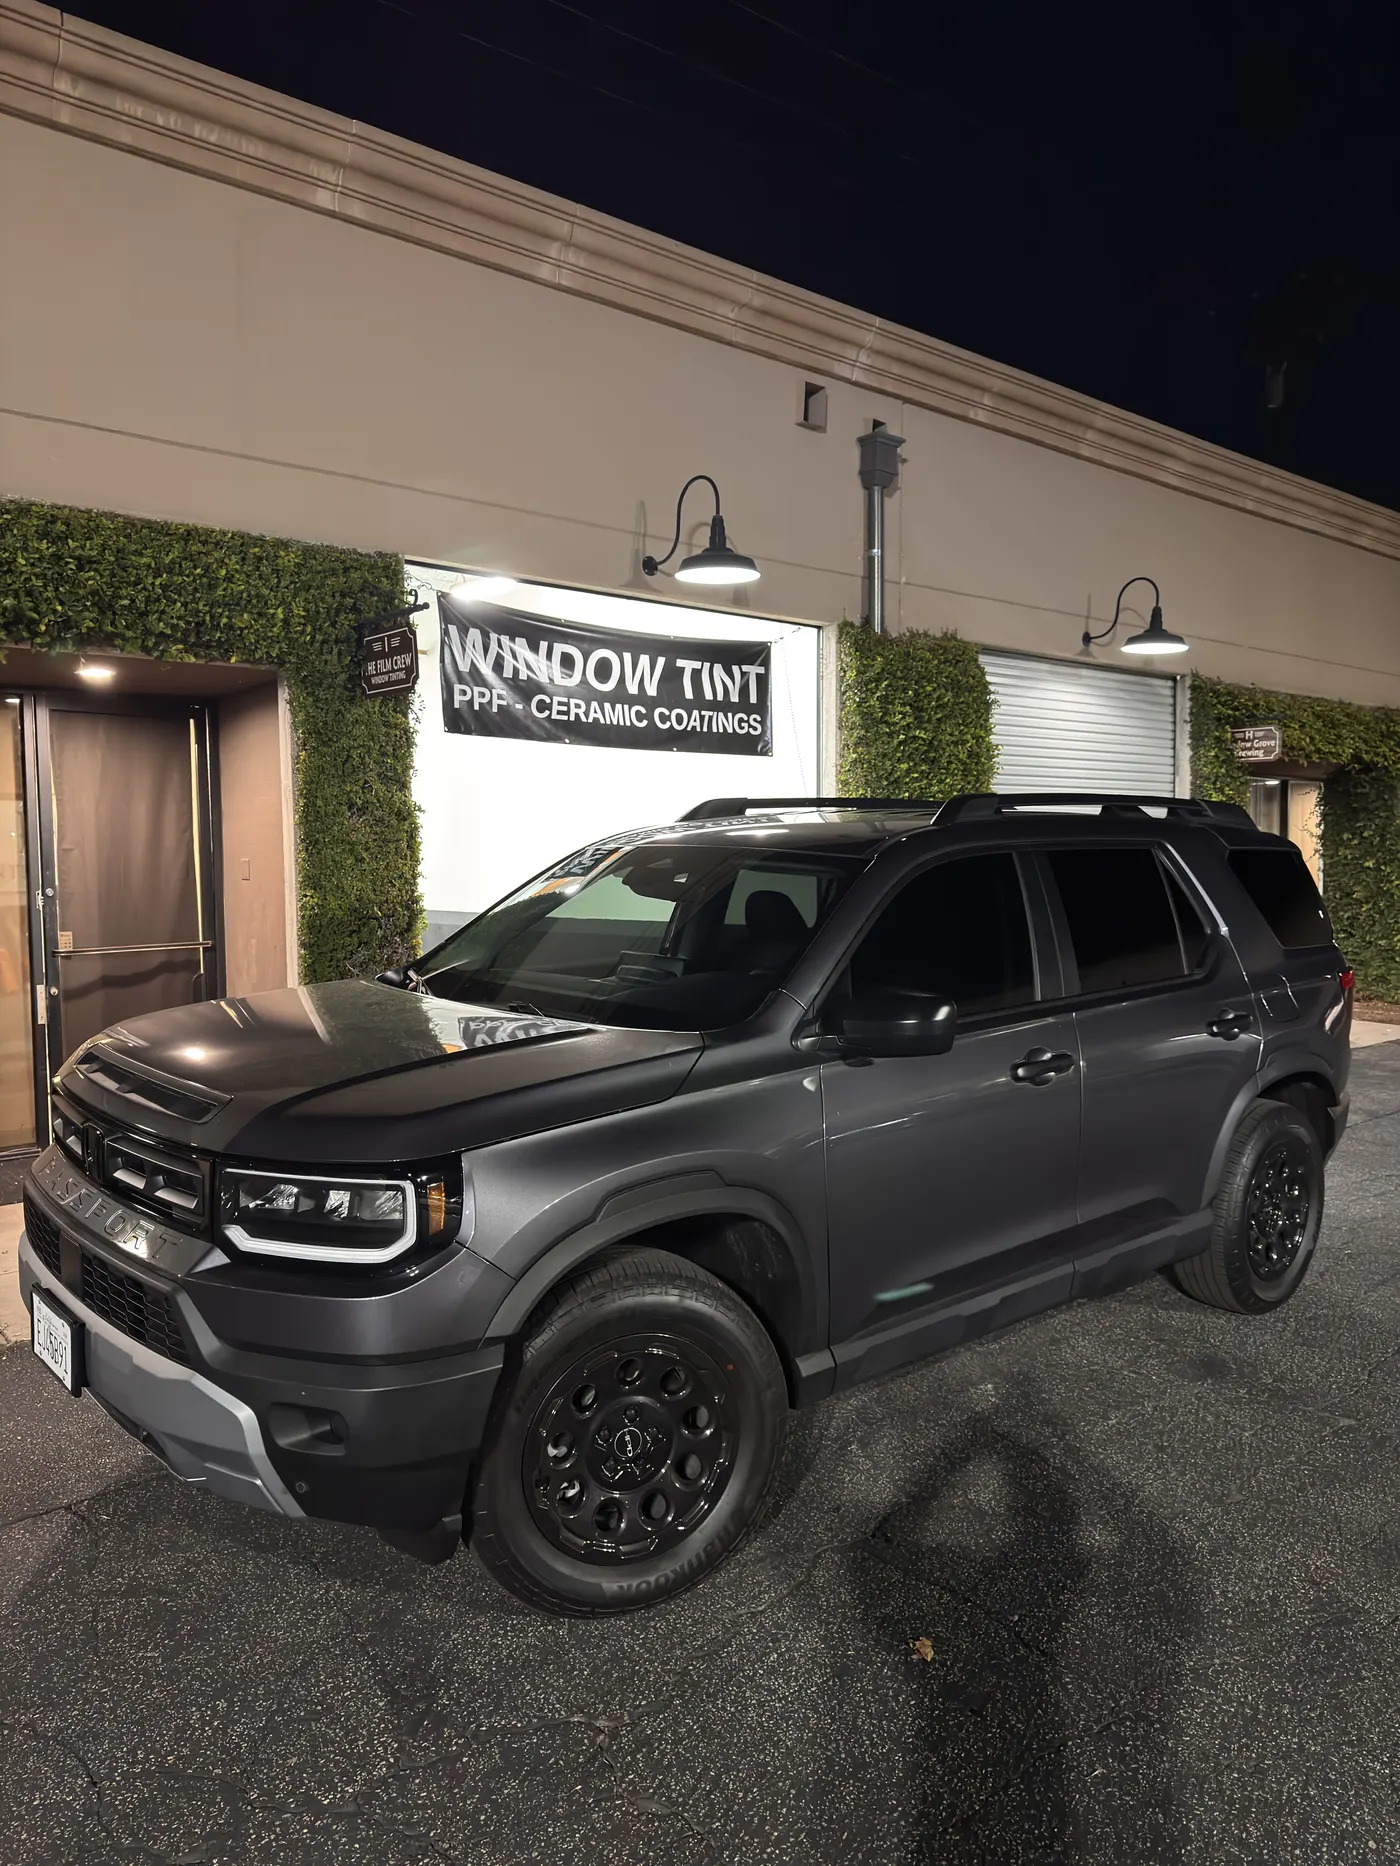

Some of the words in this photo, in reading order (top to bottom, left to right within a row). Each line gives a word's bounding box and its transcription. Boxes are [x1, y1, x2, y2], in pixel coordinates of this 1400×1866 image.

[366, 662, 376, 677] HE
[377, 658, 392, 673] FILM
[392, 653, 412, 670] CREW
[448, 624, 666, 697] WINDOW
[676, 659, 765, 704] TINT
[371, 674, 389, 684] WINDOW
[389, 671, 406, 682] TINTING
[453, 684, 507, 713] PPF
[530, 694, 647, 728] CERAMIC
[654, 707, 763, 735] COATINGS
[1245, 730, 1253, 740] H
[1253, 739, 1276, 748] Grove
